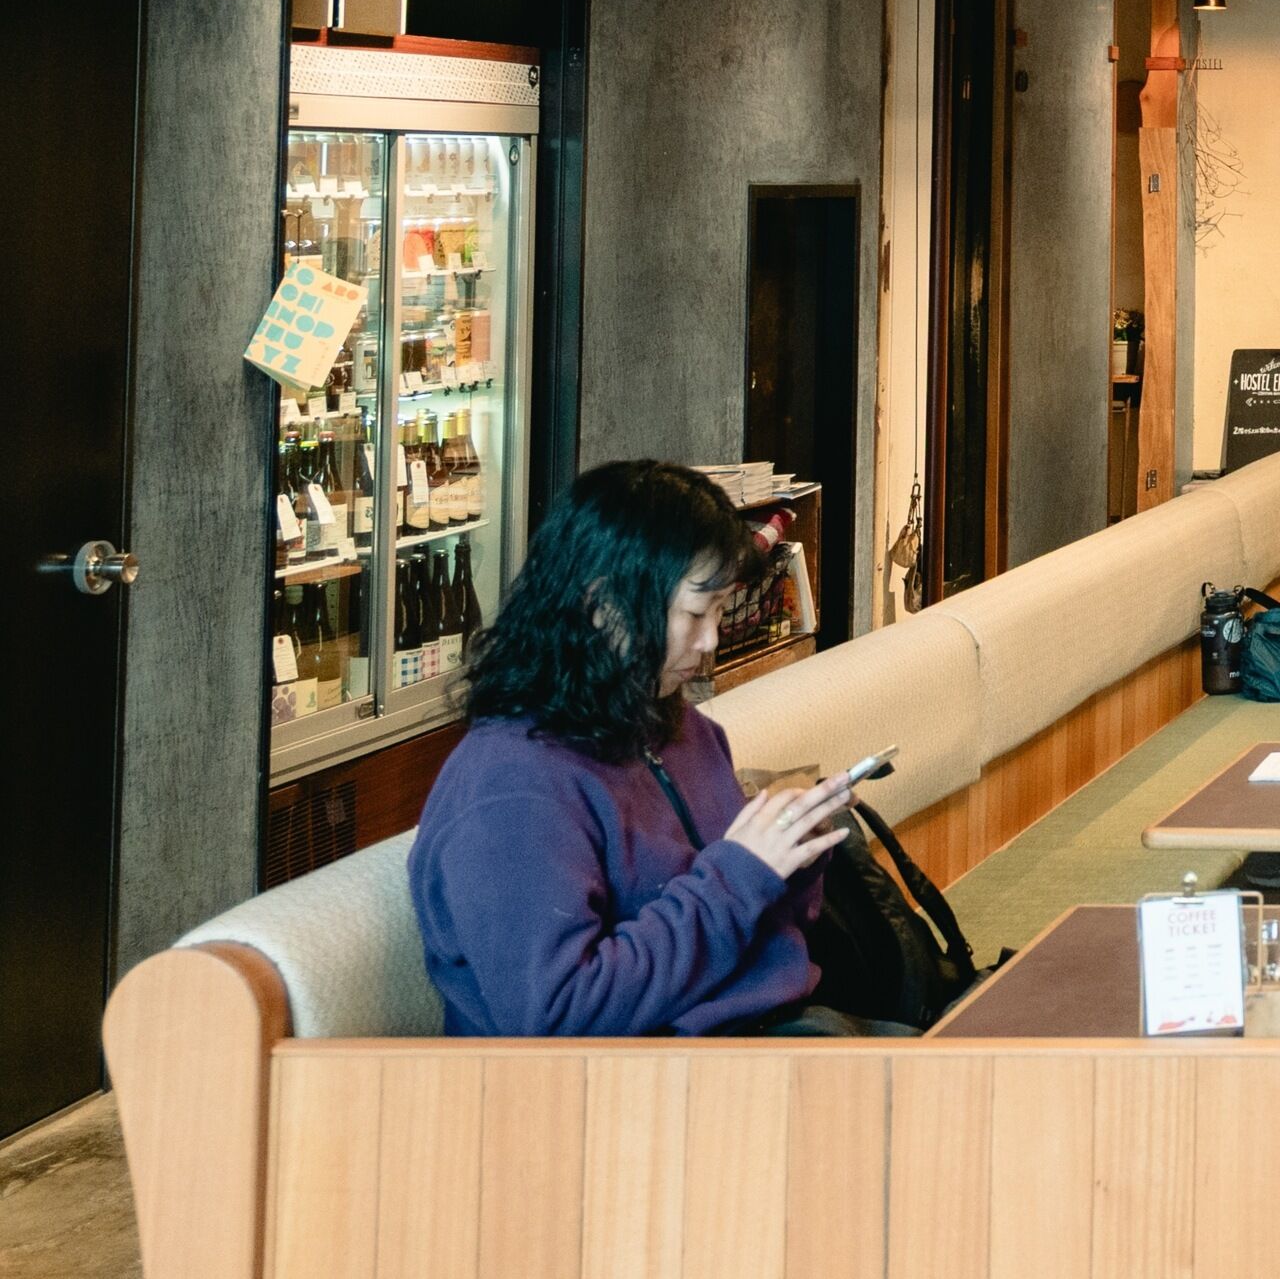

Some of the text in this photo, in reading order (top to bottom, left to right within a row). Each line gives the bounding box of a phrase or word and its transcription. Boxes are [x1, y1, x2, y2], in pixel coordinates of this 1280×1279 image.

[1240, 373, 1270, 391] HOSTEL
[1167, 909, 1217, 924] COFFEE
[1168, 923, 1217, 938] TICKET
